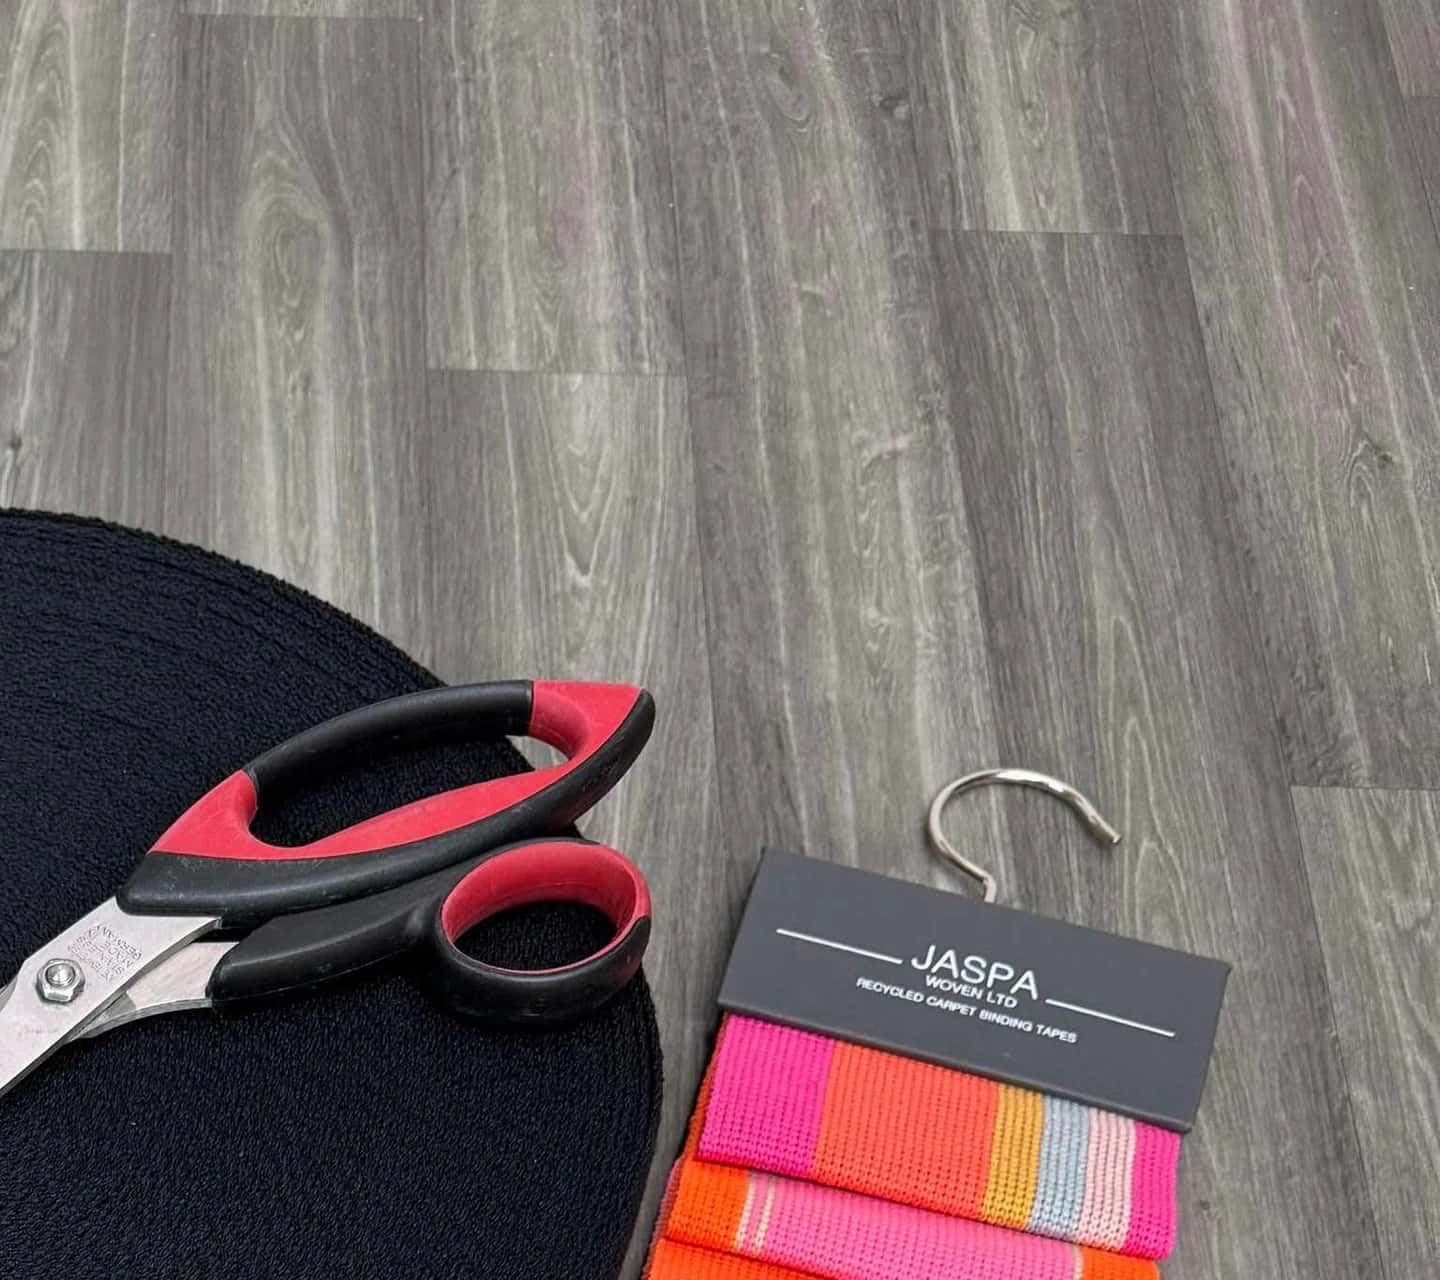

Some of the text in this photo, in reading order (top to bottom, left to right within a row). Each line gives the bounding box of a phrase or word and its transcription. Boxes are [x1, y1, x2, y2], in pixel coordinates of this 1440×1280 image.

[911, 944, 1039, 1000] JASPA
[926, 974, 1018, 1009] WOVEN LTD
[856, 977, 1078, 1044] RECYCLED CARPET BINDING TAPES
